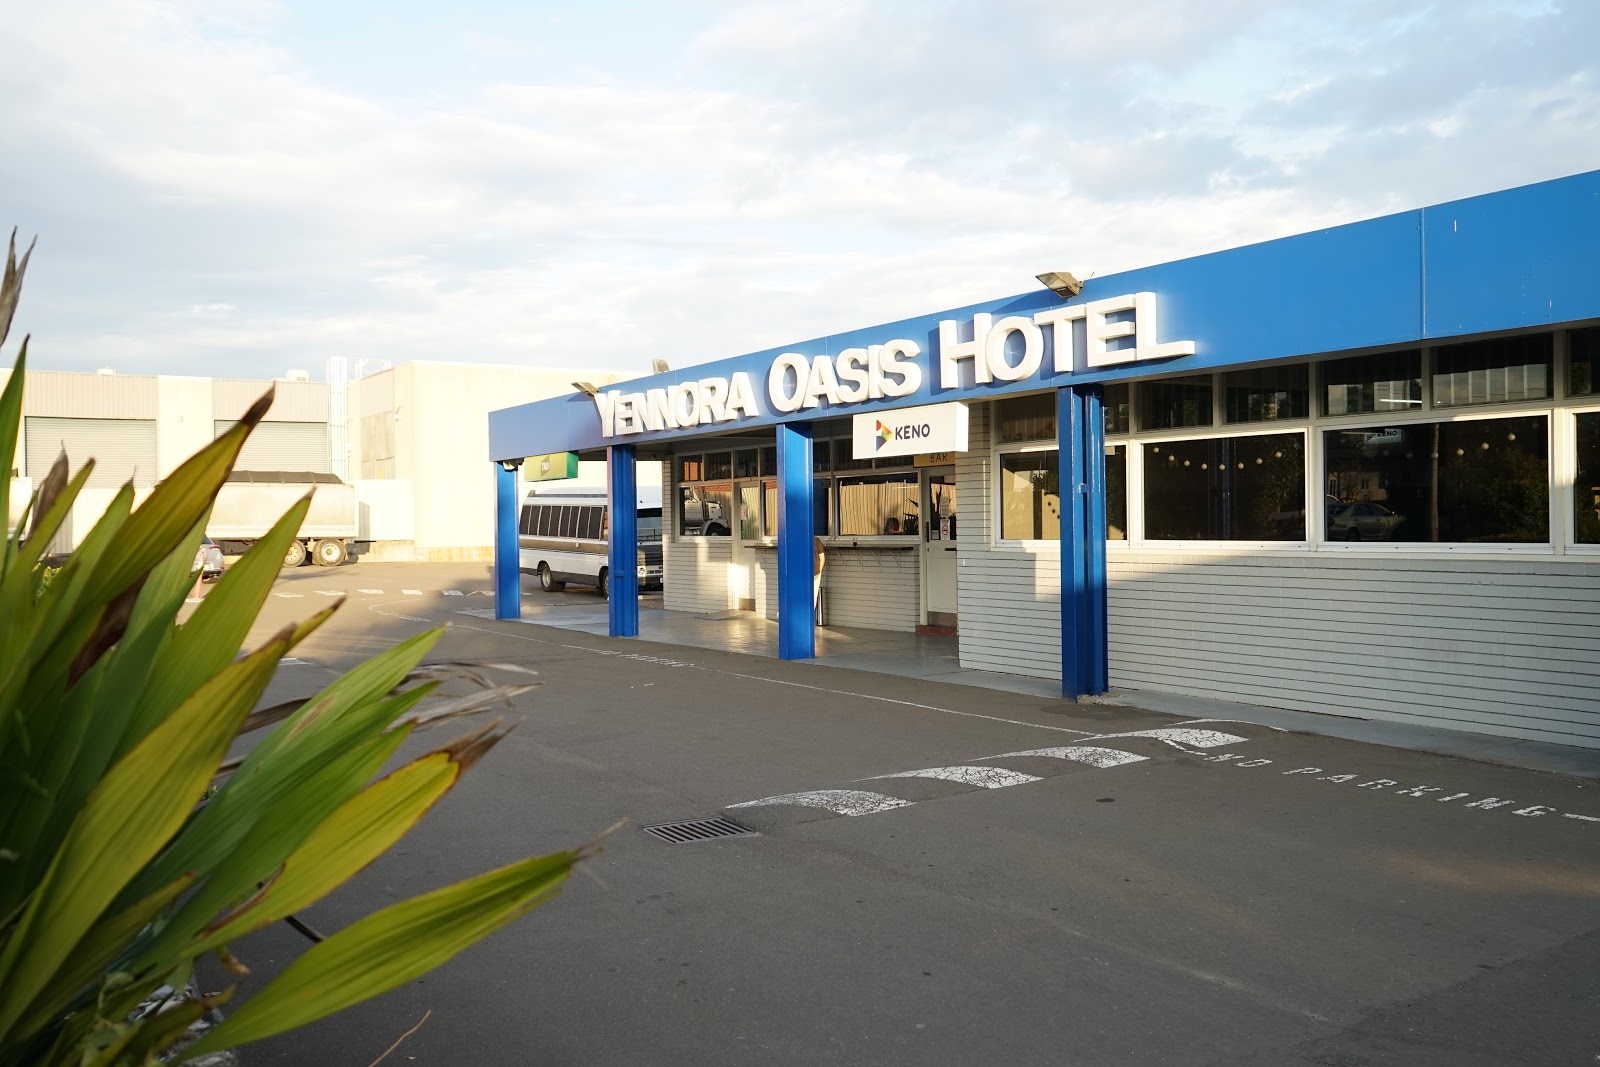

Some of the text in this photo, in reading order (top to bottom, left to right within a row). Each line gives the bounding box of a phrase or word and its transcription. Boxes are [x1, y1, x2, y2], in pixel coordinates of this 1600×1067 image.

[594, 291, 1196, 438] YENNORA OASIS HOTEL
[895, 423, 930, 441] KENO
[930, 452, 948, 463] BAR
[1282, 766, 1557, 817] PARKING
